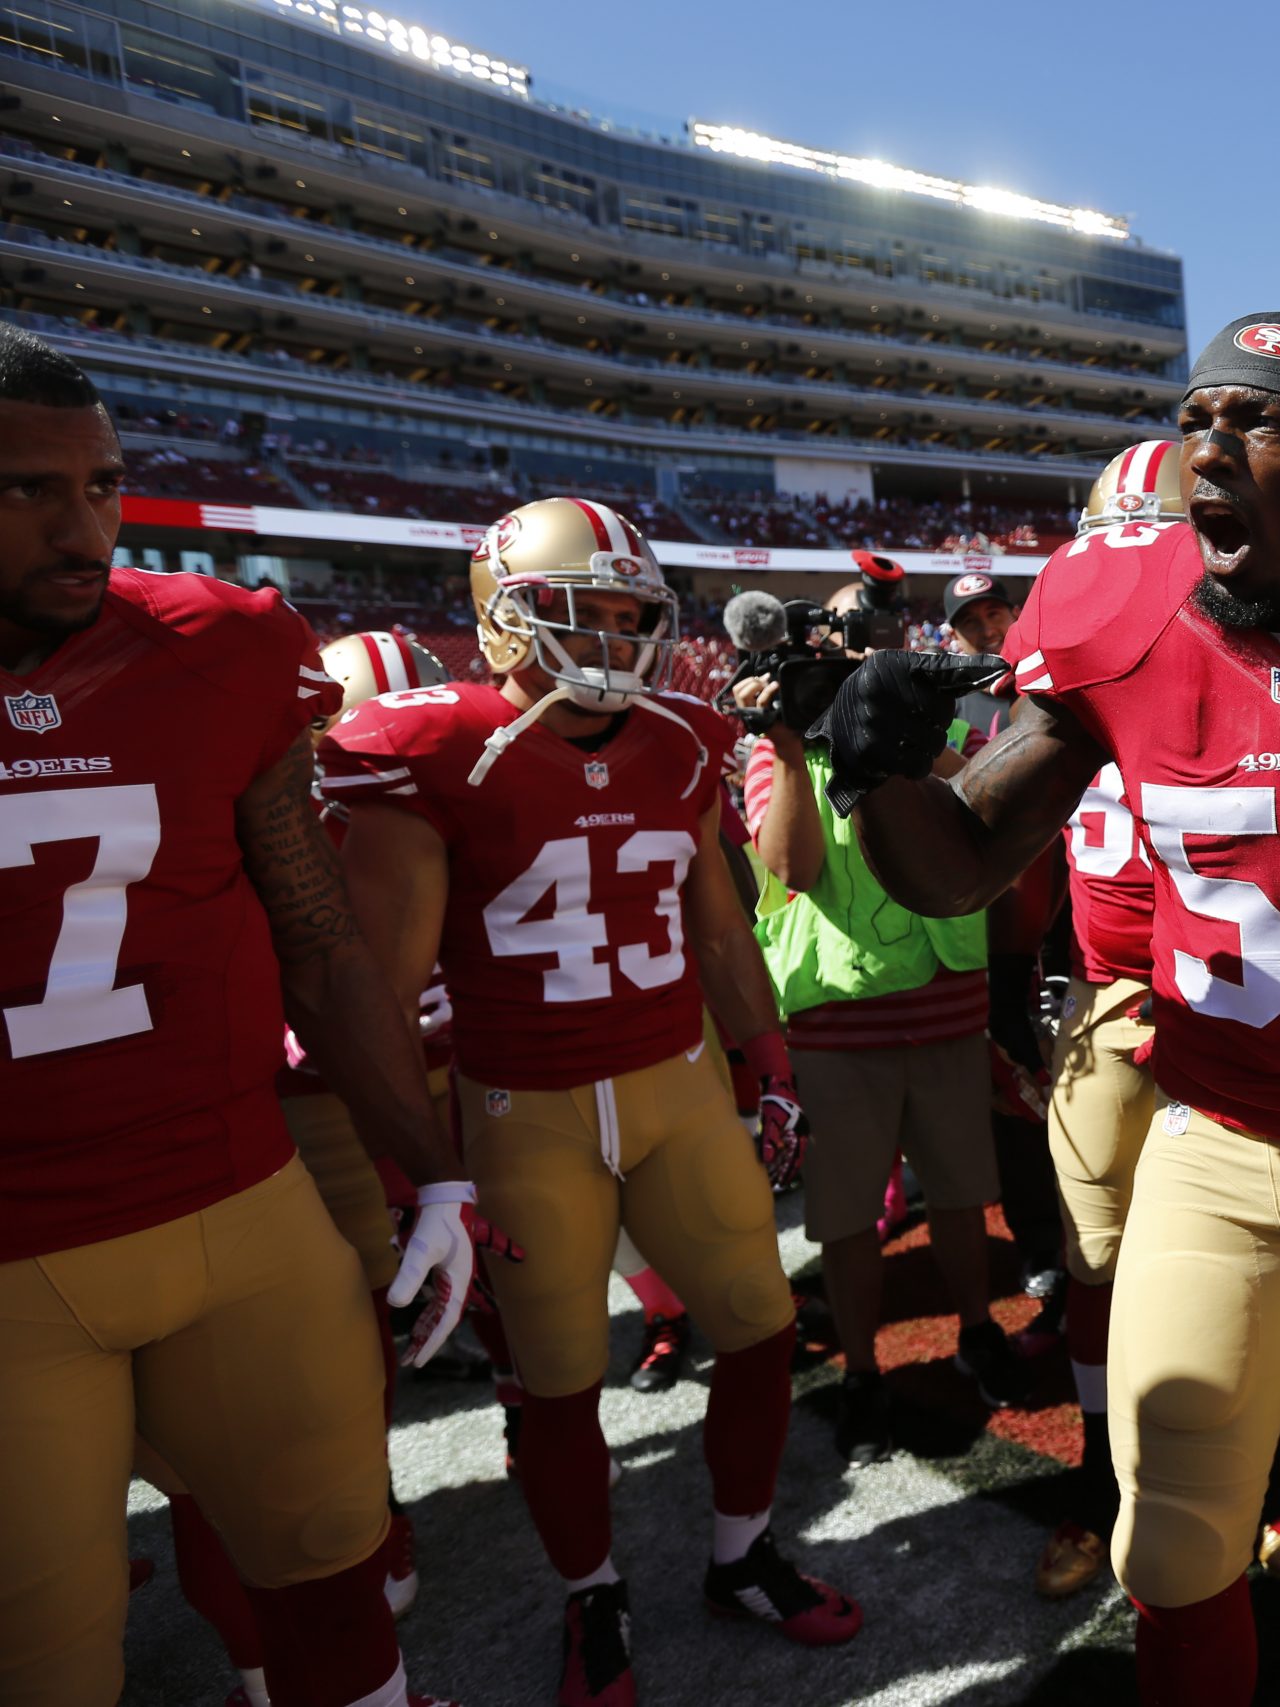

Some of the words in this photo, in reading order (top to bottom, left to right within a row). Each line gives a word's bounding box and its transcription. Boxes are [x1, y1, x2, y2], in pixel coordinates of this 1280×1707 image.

[16, 709, 54, 726] NFL
[573, 813, 636, 828] 49ERS
[0, 783, 161, 1059] 7
[483, 831, 697, 1002] 43
